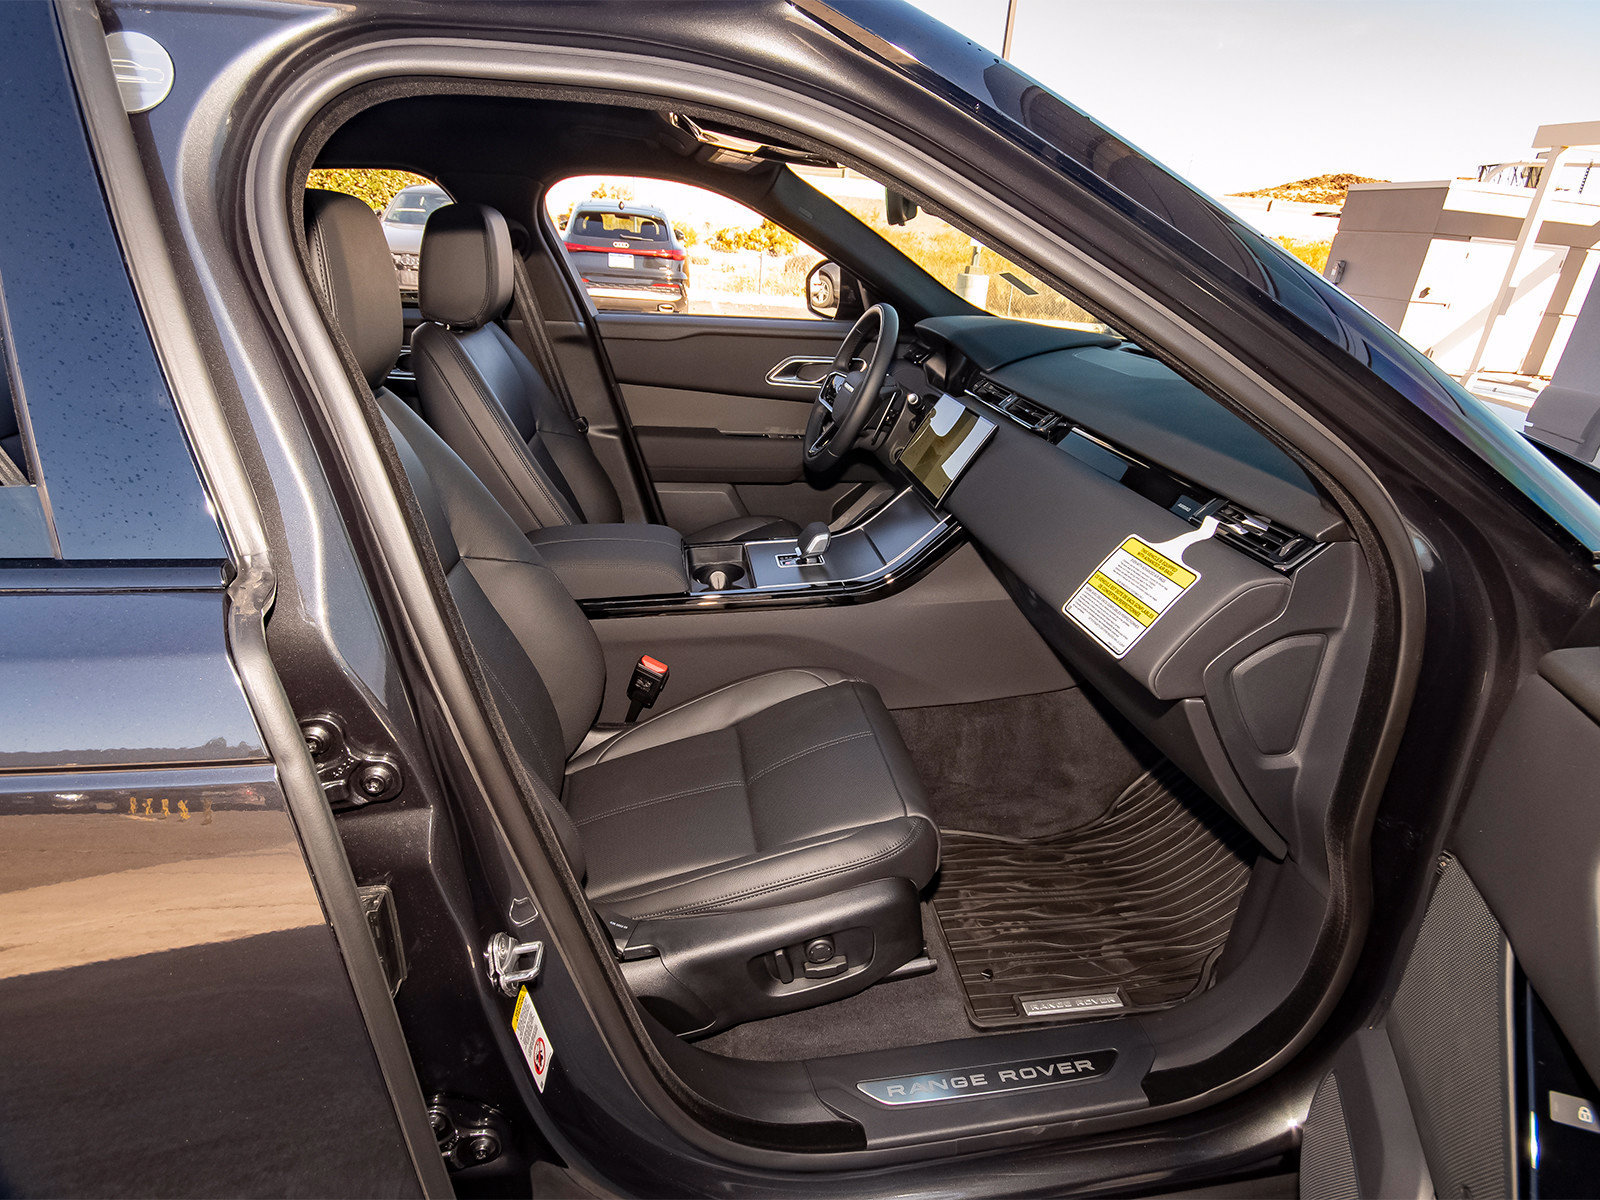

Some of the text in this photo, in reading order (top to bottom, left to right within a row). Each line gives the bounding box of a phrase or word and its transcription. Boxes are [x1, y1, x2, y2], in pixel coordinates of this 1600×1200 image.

[1030, 996, 1116, 1011] RANGE ROVER
[886, 1058, 1096, 1098] RANGE ROVER
